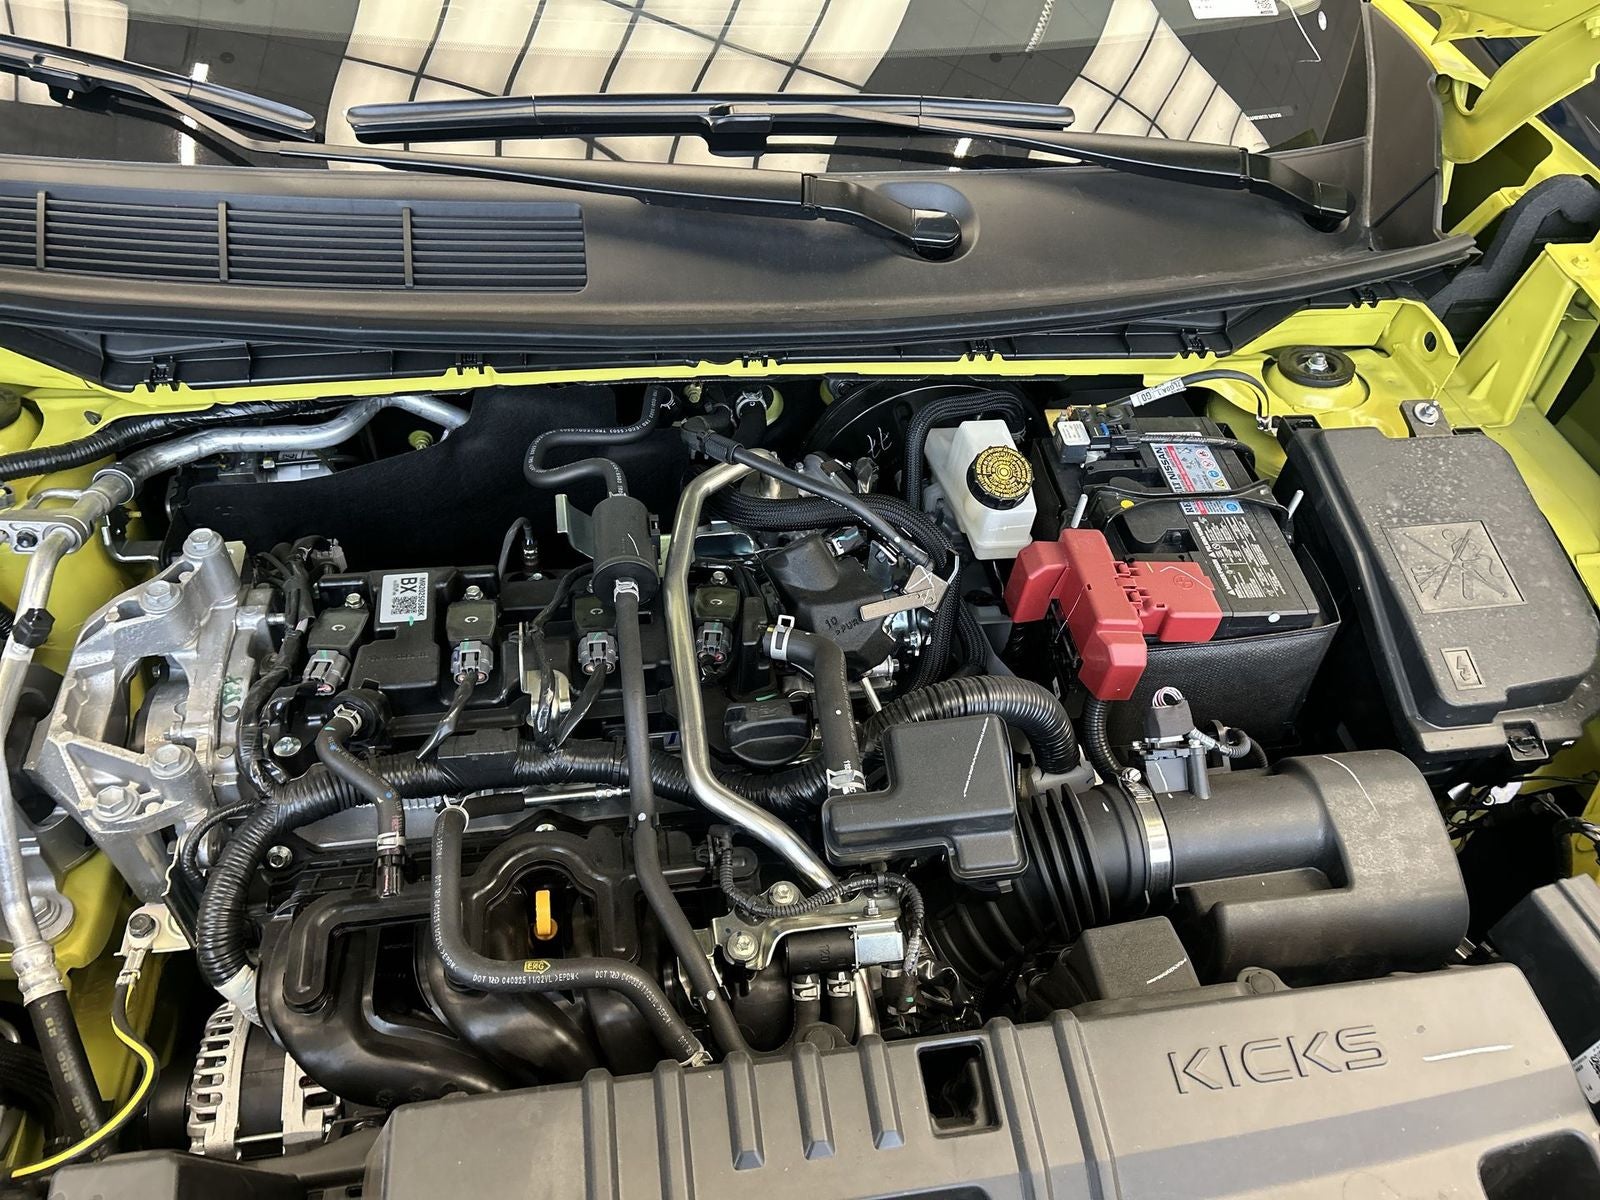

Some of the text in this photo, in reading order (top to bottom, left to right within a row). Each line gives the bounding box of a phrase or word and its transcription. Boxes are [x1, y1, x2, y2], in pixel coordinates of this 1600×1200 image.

[1158, 447, 1176, 481] NISSAN
[400, 577, 417, 594] BX
[472, 974, 486, 983] DOT
[595, 970, 608, 979] DOT
[1166, 1024, 1389, 1095] KICKS
